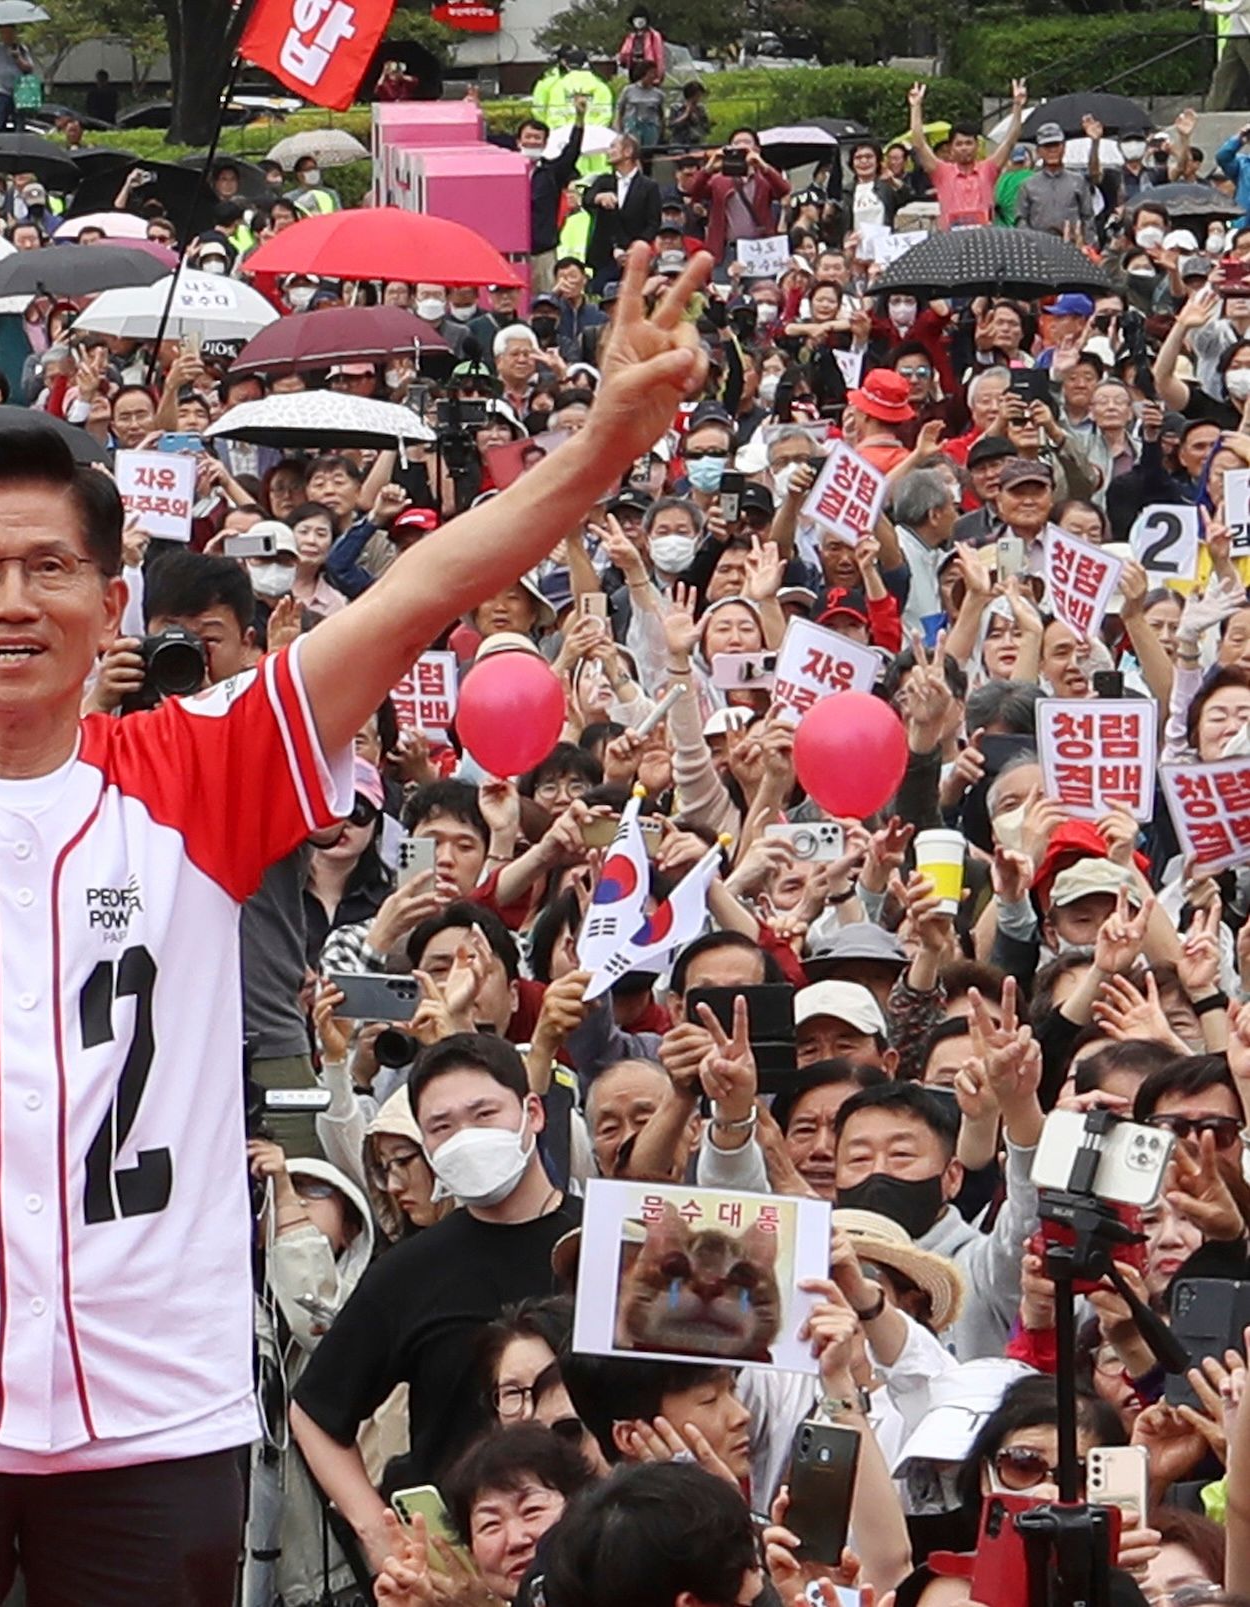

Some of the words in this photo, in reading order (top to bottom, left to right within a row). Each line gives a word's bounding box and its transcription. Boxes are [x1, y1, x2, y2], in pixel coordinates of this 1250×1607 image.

[133, 467, 176, 492] 자유
[833, 455, 878, 507] 청렴
[120, 495, 189, 519] 민주주의
[815, 484, 871, 538] 결백
[1141, 511, 1183, 573] 2
[1052, 541, 1108, 600] 청렴
[800, 647, 855, 692] 자유
[1052, 712, 1140, 760] 청렴
[1054, 763, 1142, 809] 결백
[80, 944, 174, 1226] 2
